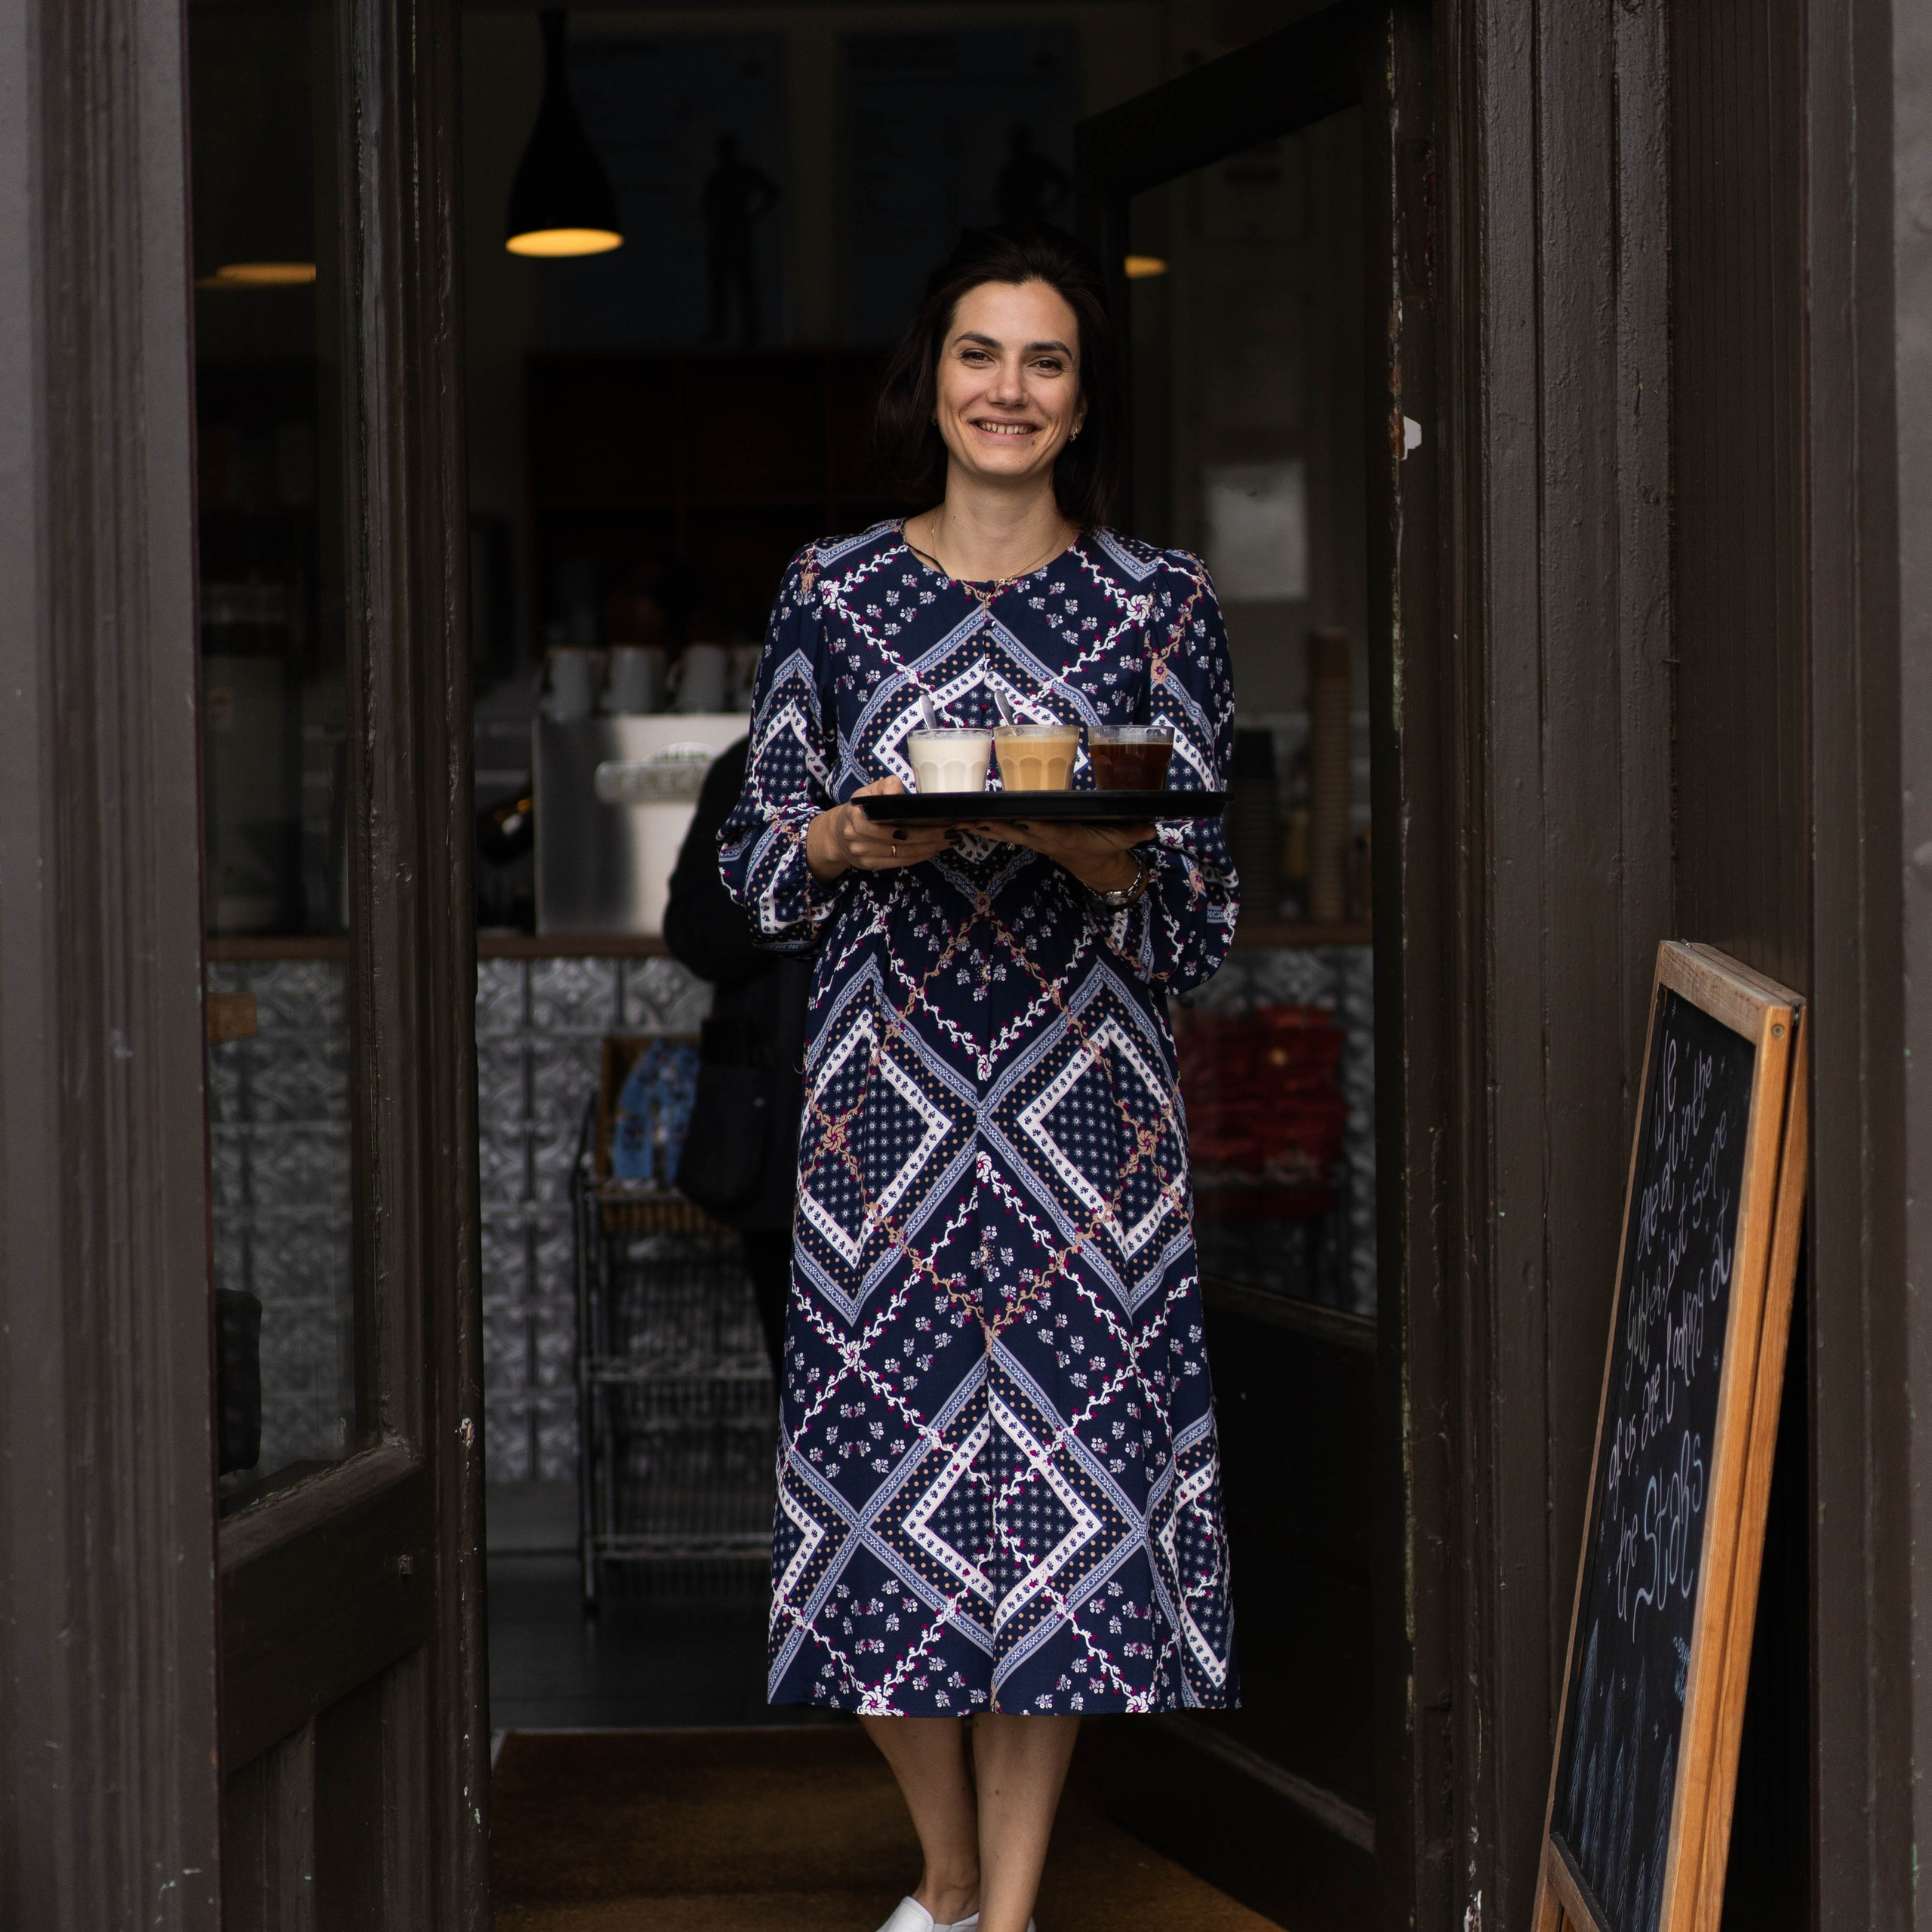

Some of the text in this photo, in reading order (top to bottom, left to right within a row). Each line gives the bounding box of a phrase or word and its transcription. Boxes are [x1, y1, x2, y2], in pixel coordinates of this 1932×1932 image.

[1637, 1049, 1712, 1262] are all in the
[1655, 1029, 1677, 1152] We
[1664, 1182, 1688, 1320] but
[1692, 1110, 1727, 1230] some
[1609, 1187, 1731, 1521] of us are looking at
[1616, 1506, 1638, 1622] the
